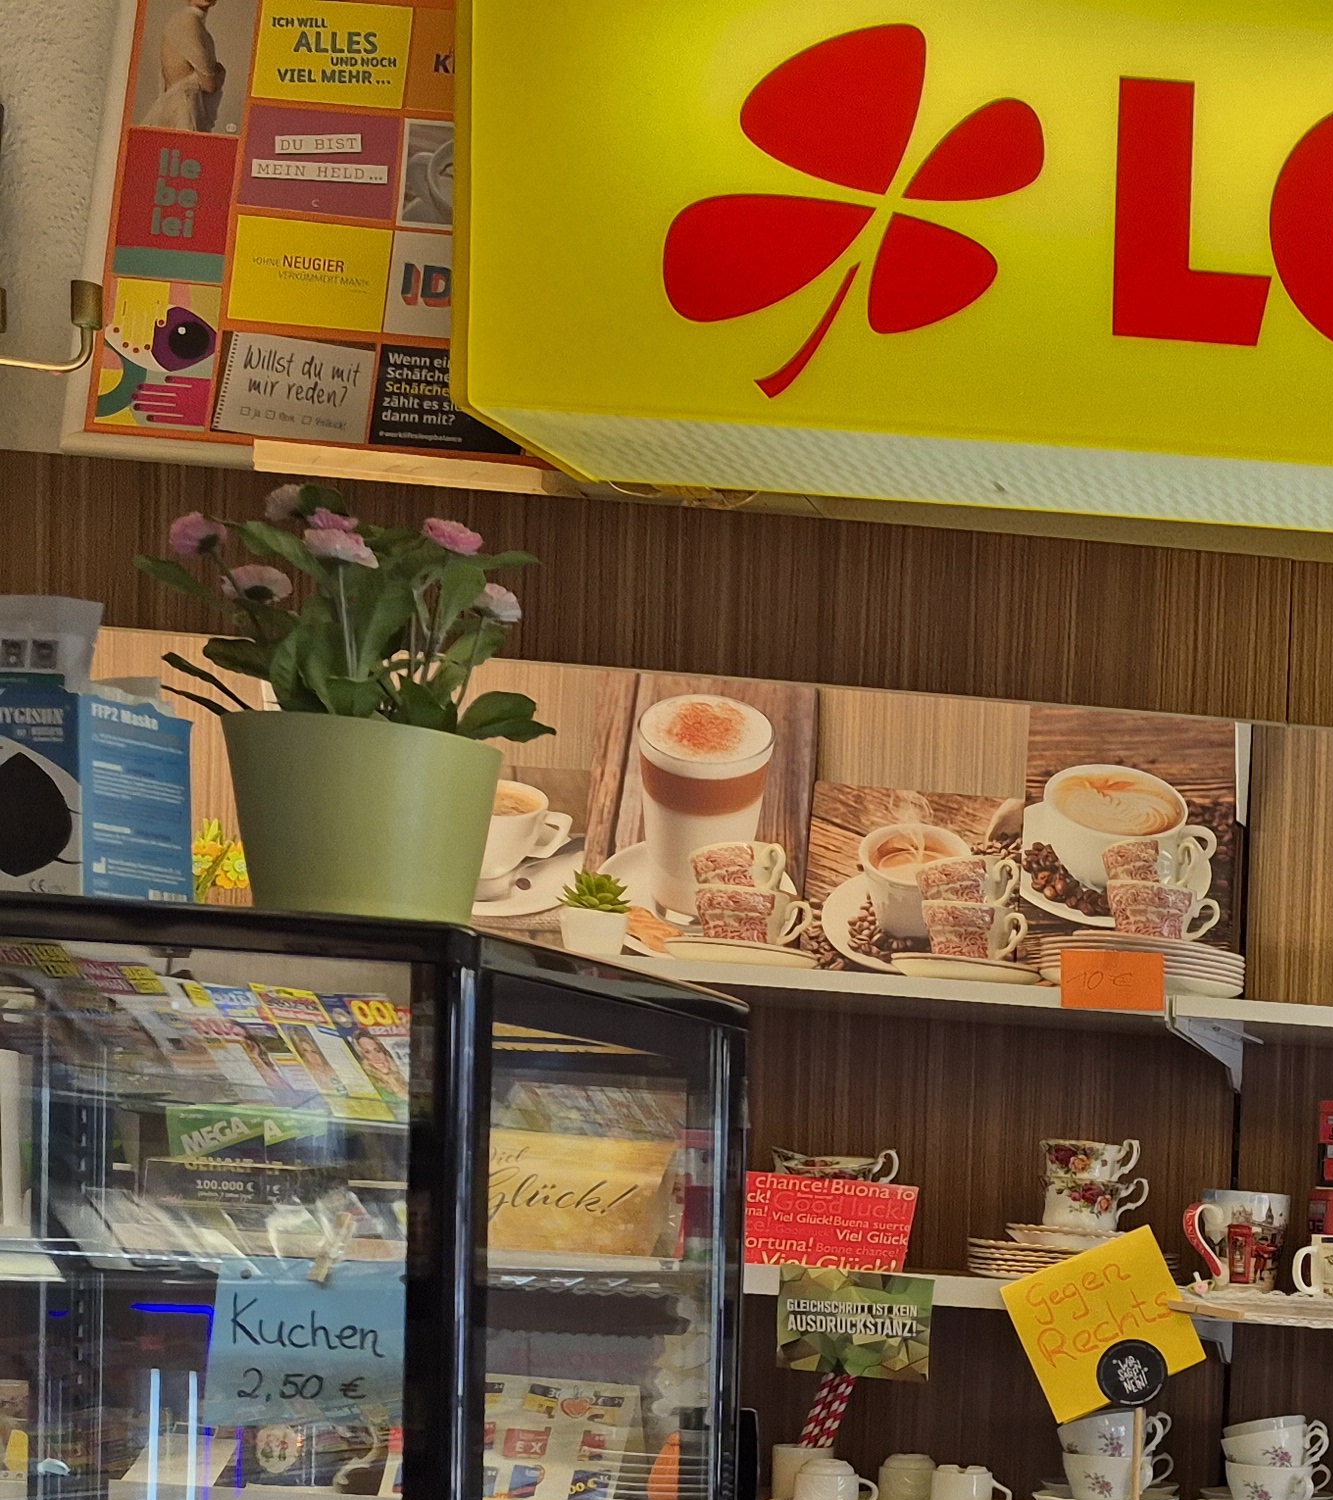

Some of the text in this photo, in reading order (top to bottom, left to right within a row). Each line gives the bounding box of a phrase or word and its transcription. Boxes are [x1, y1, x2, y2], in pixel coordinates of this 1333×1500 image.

[272, 17, 328, 28] ICH WILL
[293, 31, 378, 54] ALLES
[330, 56, 397, 68] UND NOCH
[277, 68, 317, 83] VIEL
[280, 138, 358, 150] DU BIST
[159, 148, 201, 179] lie
[257, 163, 306, 176] MEIN
[154, 178, 198, 208] be
[151, 207, 194, 238] lei
[283, 255, 345, 273] NEUGIER
[244, 344, 361, 387] Willst du mit
[388, 352, 432, 368] Wenn
[248, 377, 347, 408] mir reden?
[382, 395, 439, 411] zählt es
[382, 410, 455, 425] dann mit?
[91, 703, 158, 731] FFP2 Maske
[1066, 971, 1133, 990] 10 €
[180, 1116, 250, 1155] MEGA
[196, 1179, 254, 1191] 100.000 €
[756, 1174, 889, 1199] chance! Buona
[774, 1191, 843, 1214] Good
[851, 1198, 907, 1220] luck!
[772, 1212, 869, 1229] Viel Glück! Buena
[836, 1229, 862, 1242] Viel
[816, 1243, 853, 1253] Bonne
[856, 1246, 901, 1257] chance!
[1025, 1263, 1131, 1325] Gegen
[787, 1299, 918, 1317] GLEICHSCHRITT IST KEIN
[230, 1292, 385, 1357] Kuchen
[787, 1315, 917, 1337] AUSDRUCKSTANZ!
[1037, 1289, 1172, 1368] Rechts
[237, 1367, 368, 1403] 2,50 €
